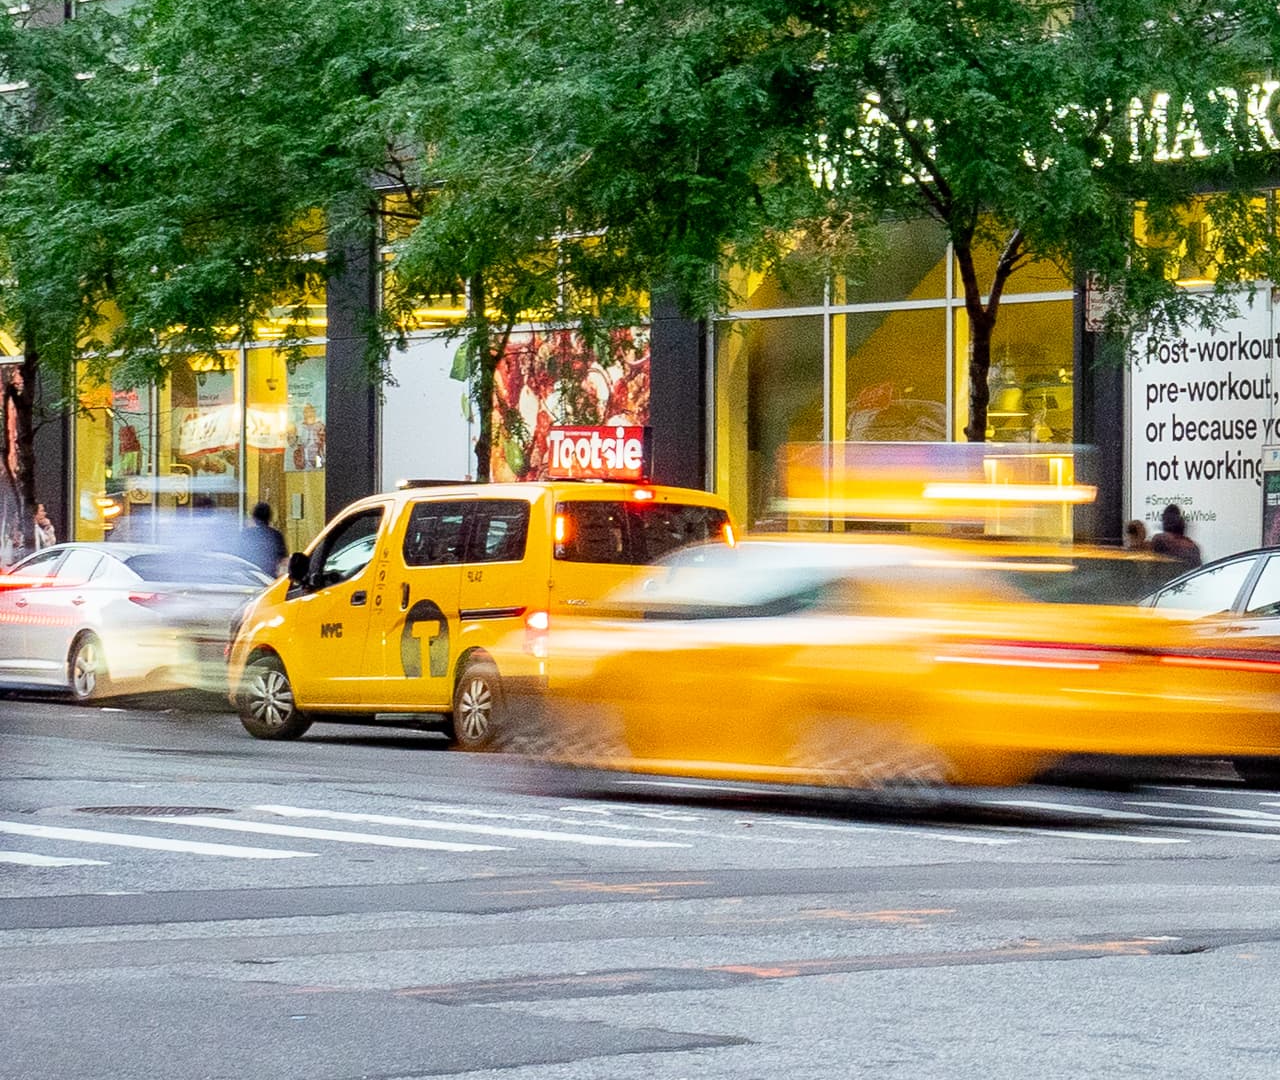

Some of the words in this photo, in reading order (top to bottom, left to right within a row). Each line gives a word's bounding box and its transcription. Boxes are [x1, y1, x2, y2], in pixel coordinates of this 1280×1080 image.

[1146, 371, 1279, 410] pre-workout,
[1146, 421, 1166, 443] or
[1172, 413, 1257, 441] because
[550, 426, 642, 470] Tootsie
[1146, 455, 1179, 482] not
[1145, 492, 1193, 506] #Smoothies
[321, 622, 344, 639] NYC
